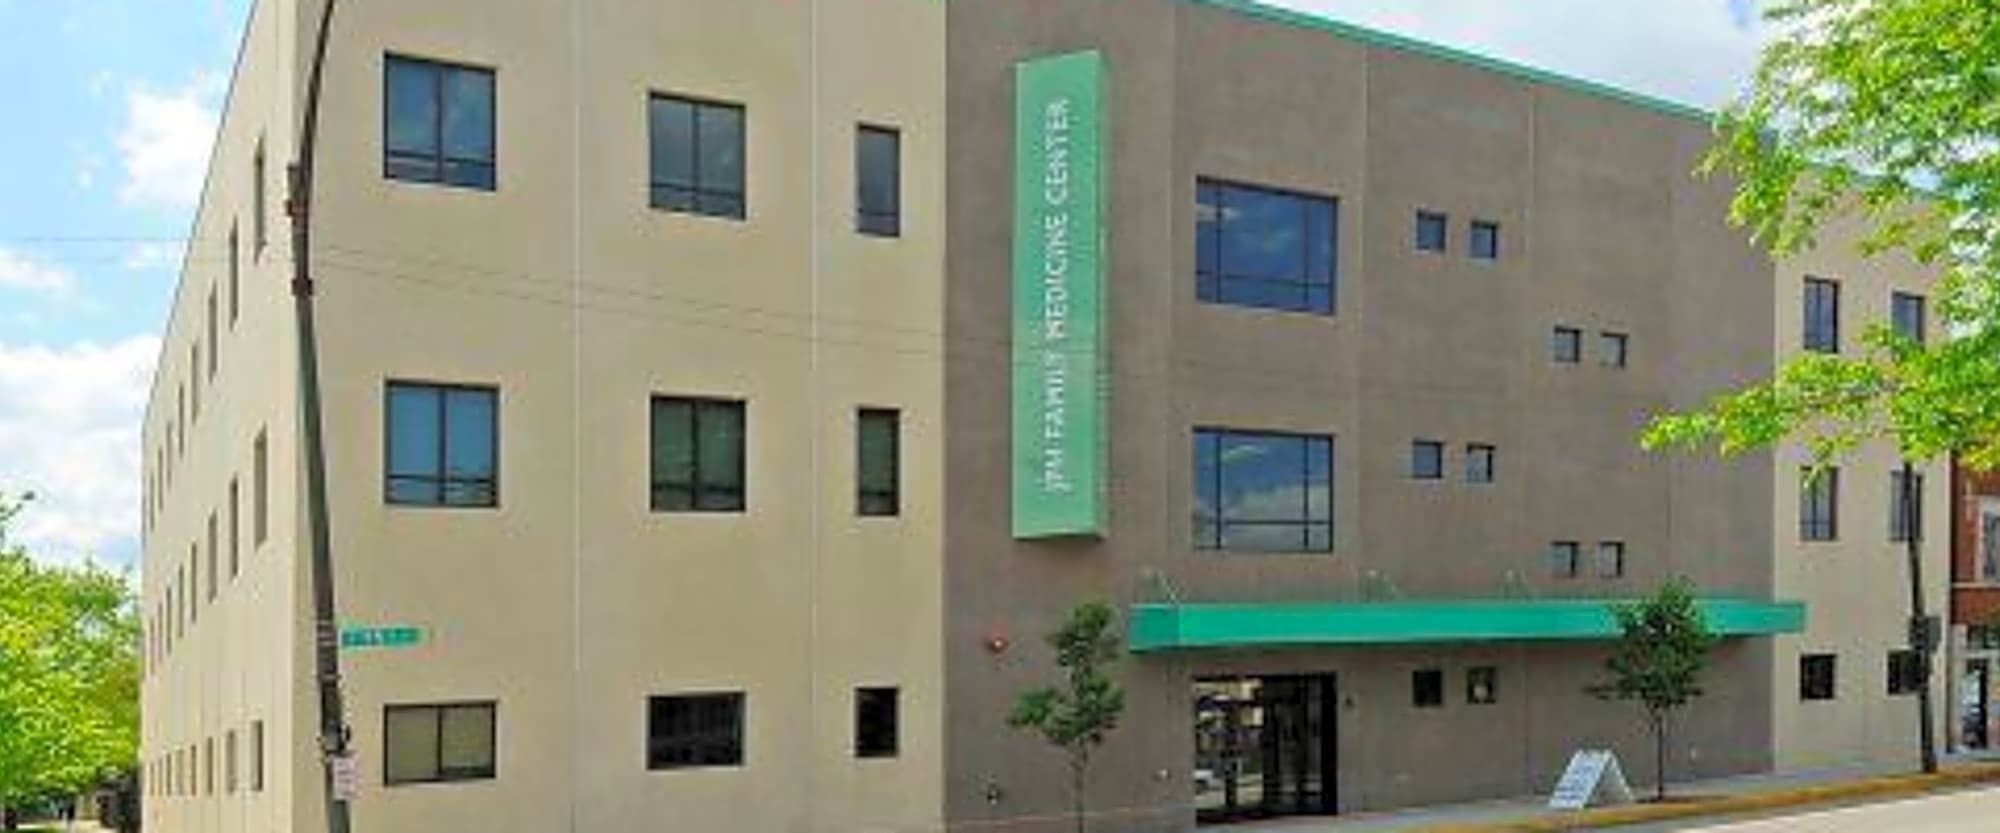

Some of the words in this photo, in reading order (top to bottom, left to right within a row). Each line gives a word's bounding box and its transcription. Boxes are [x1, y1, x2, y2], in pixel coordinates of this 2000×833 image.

[1044, 98, 1070, 205] CENTER
[1044, 211, 1068, 342] MEDICINE
[1044, 350, 1065, 439] FAMILY
